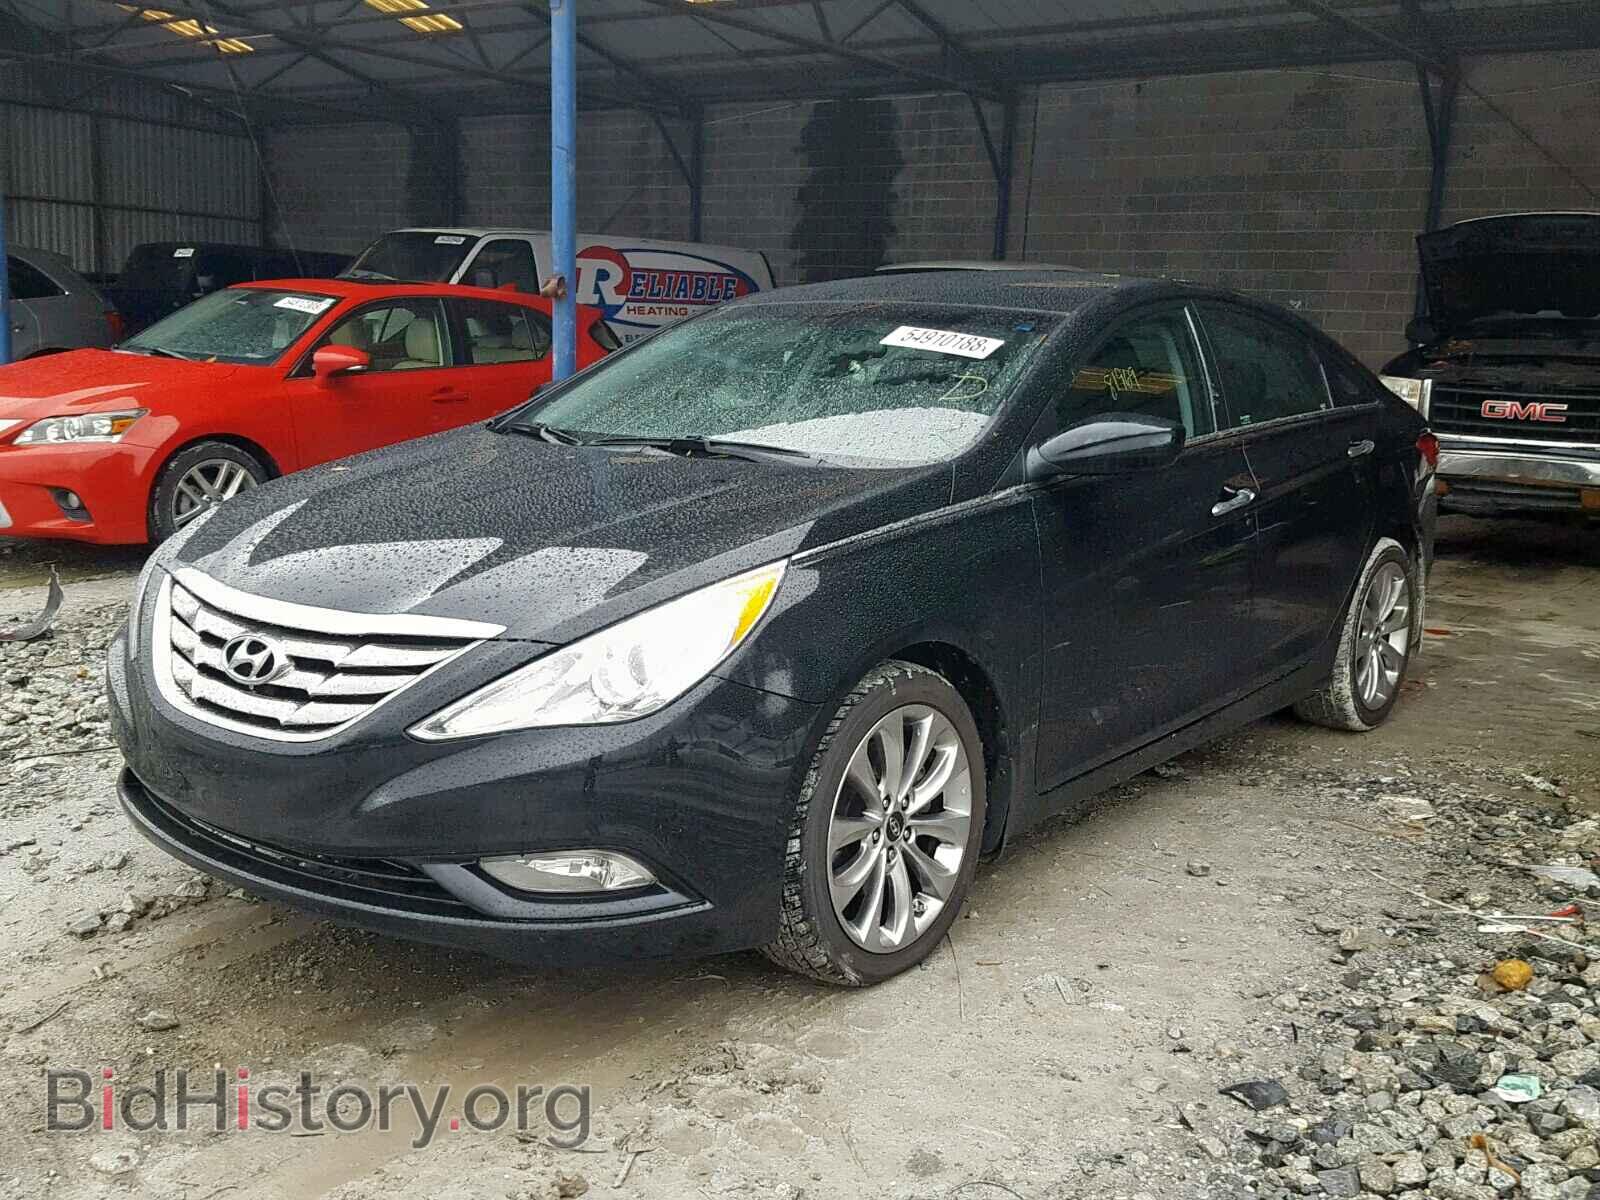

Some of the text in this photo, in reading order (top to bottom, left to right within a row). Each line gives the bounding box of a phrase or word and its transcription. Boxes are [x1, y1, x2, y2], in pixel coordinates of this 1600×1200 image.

[576, 258, 738, 304] RELIABLE
[626, 305, 688, 316] HEATING
[1481, 400, 1568, 422] GMC
